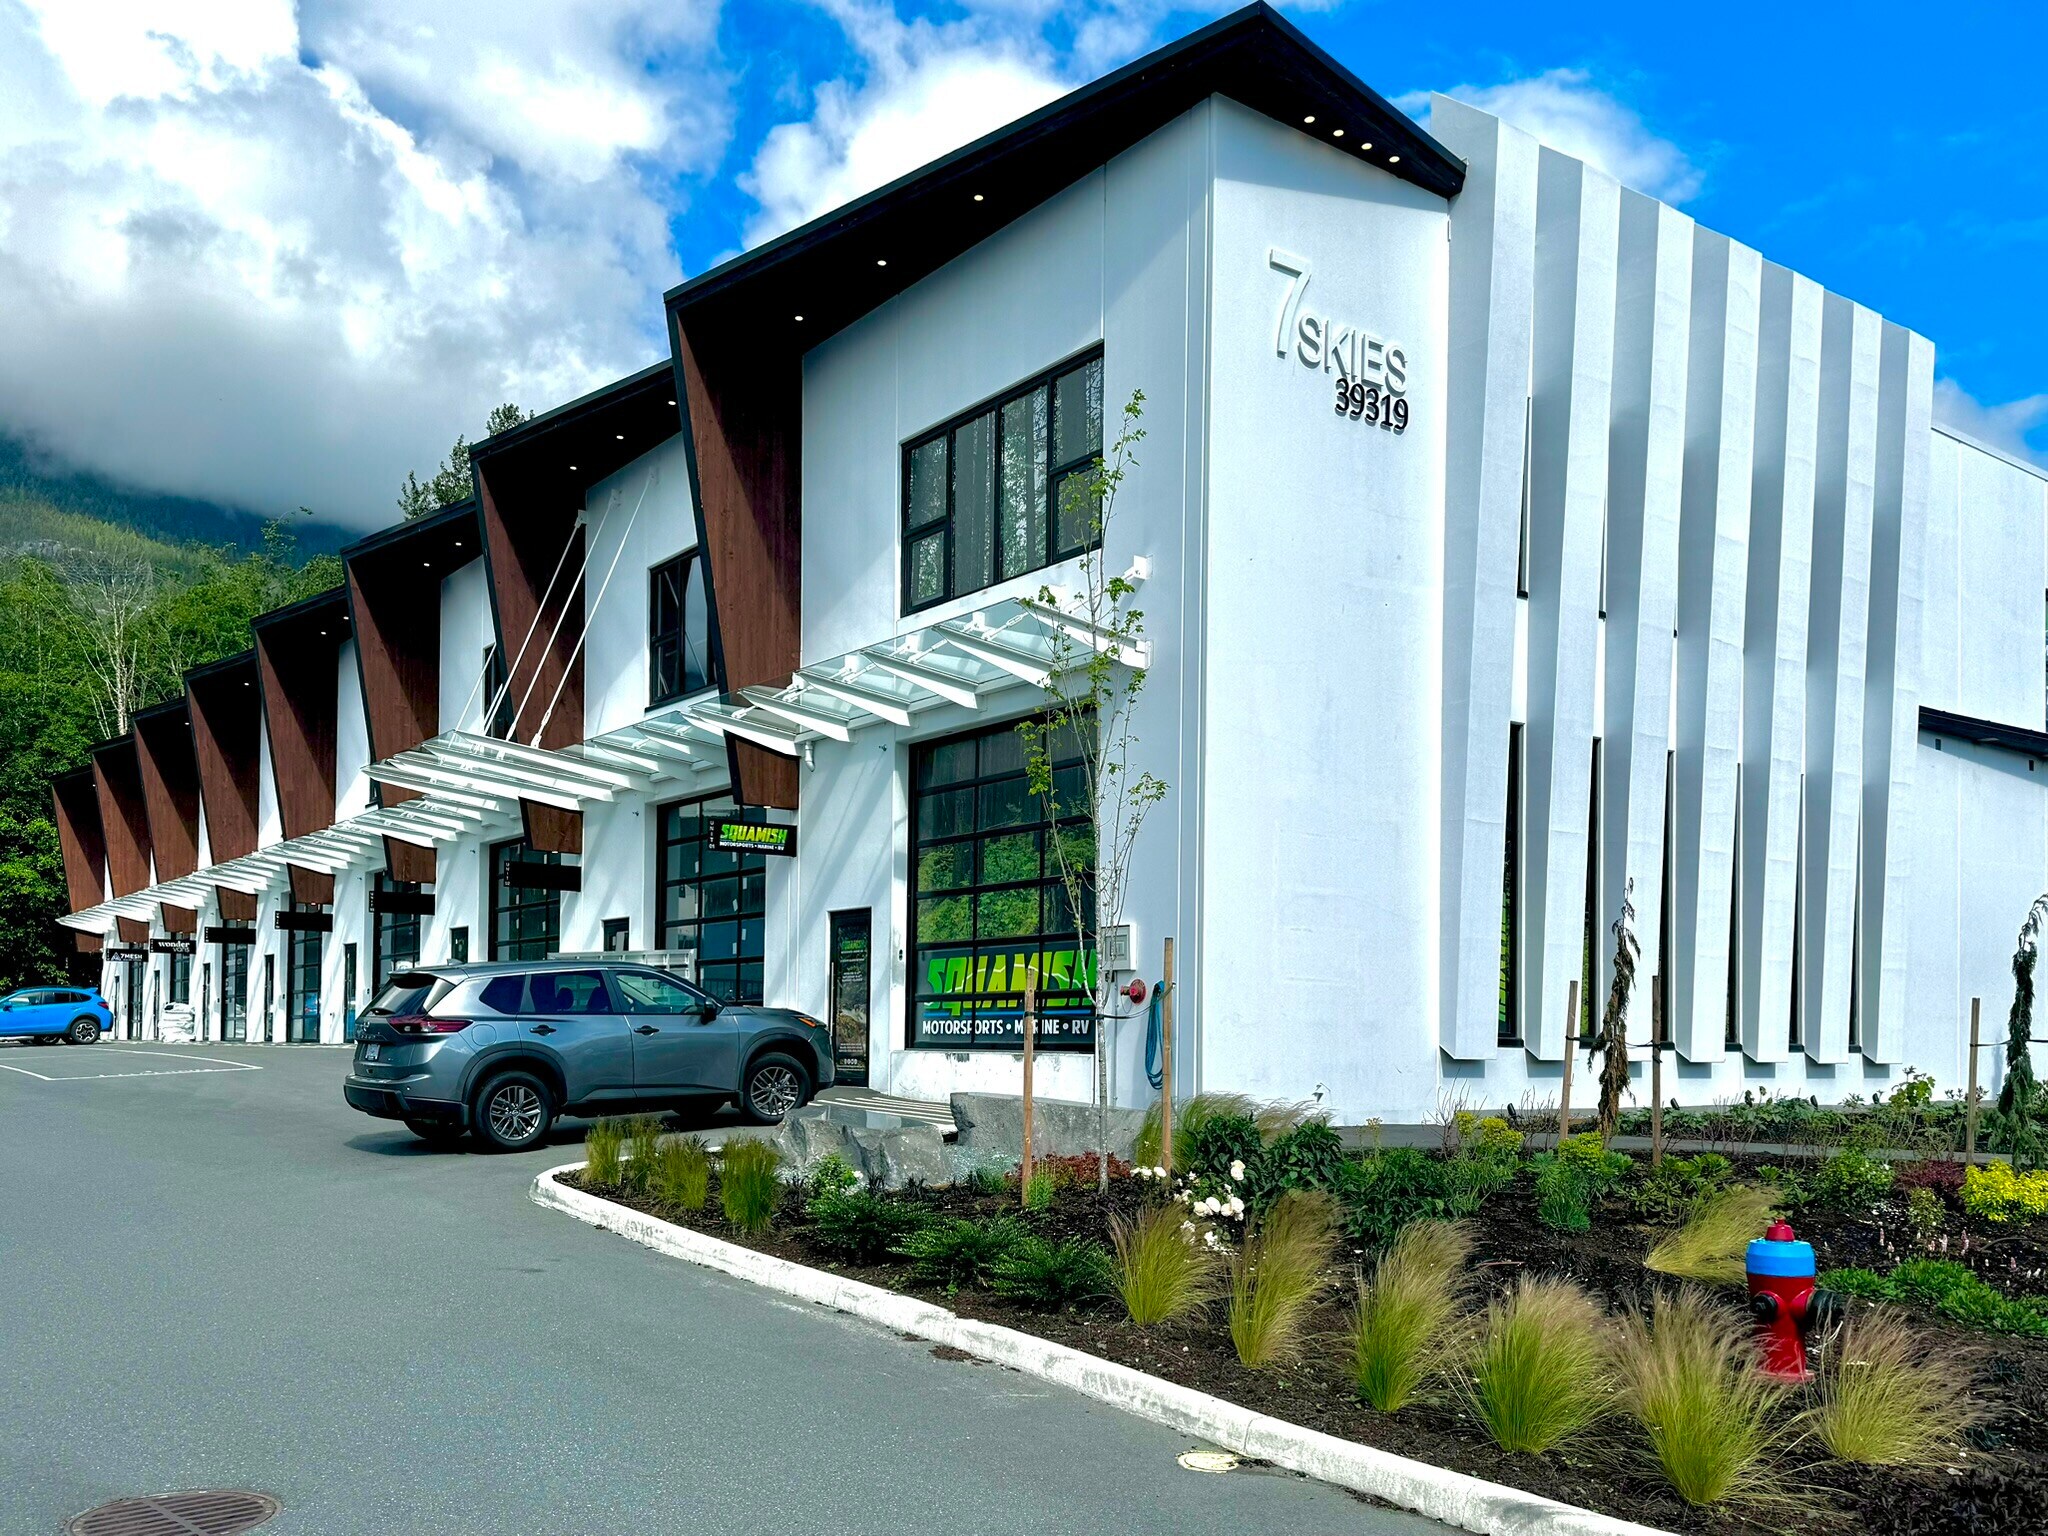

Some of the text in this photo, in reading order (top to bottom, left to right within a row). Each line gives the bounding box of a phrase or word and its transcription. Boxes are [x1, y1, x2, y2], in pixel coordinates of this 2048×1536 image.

[1269, 248, 1408, 399] 7 SKIES
[1335, 377, 1409, 434] 39319
[719, 841, 754, 849] MOTORSPORTS
[720, 823, 788, 844] SQUAMISH
[923, 948, 1097, 1016] SQUAMISH
[922, 1018, 1090, 1035] MOTORSPORTS MRINE RV
